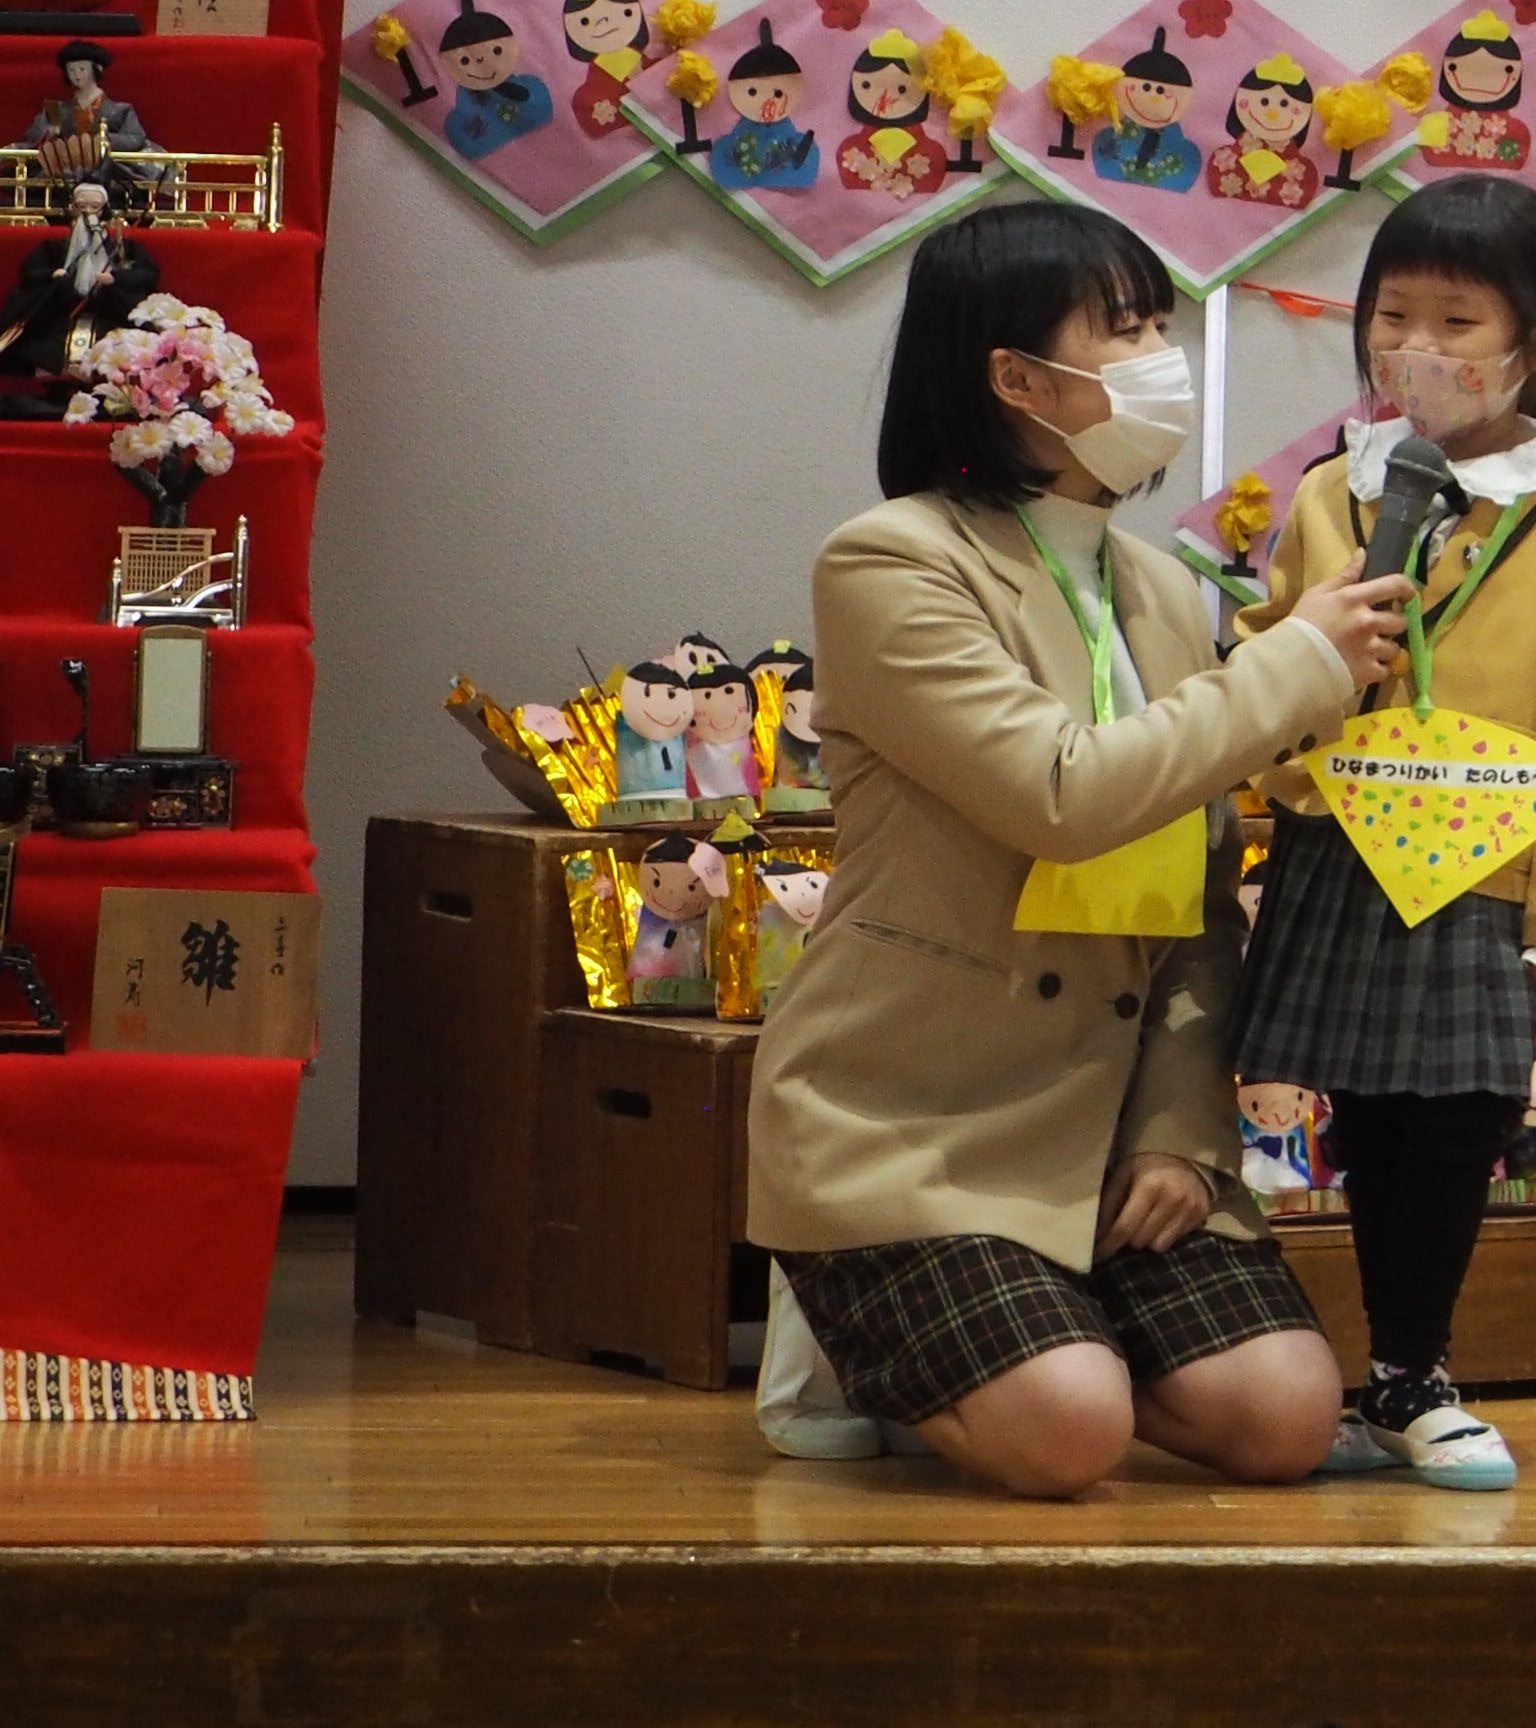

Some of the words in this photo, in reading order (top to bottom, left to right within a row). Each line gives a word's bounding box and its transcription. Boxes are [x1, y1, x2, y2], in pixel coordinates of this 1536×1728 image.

[1331, 756, 1450, 782] ひなまつりかい
